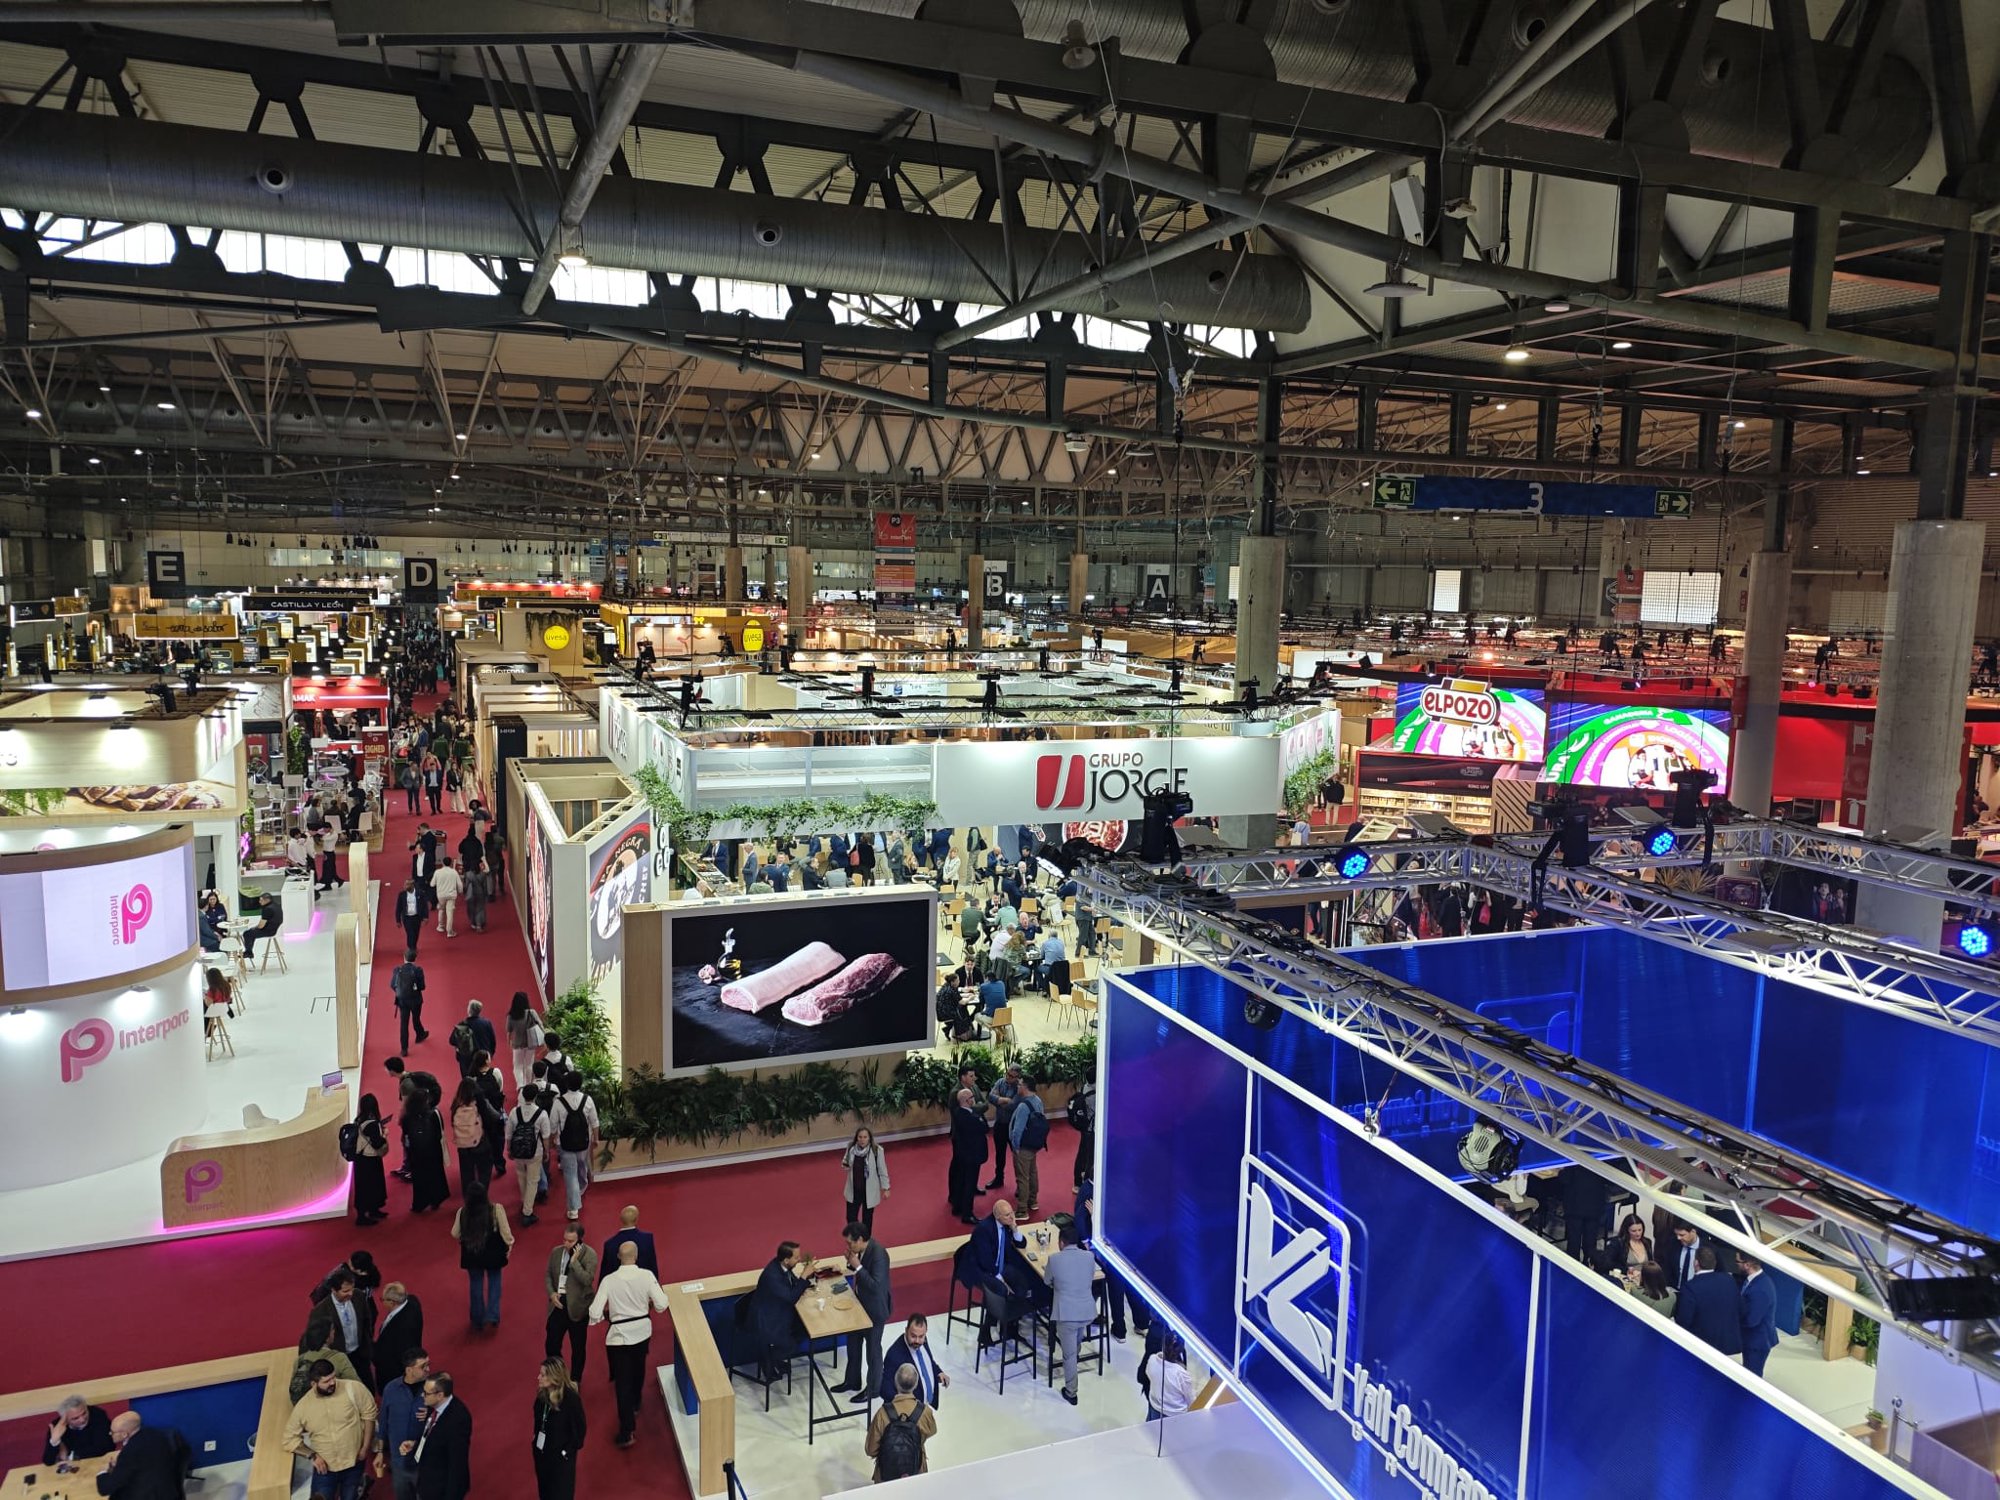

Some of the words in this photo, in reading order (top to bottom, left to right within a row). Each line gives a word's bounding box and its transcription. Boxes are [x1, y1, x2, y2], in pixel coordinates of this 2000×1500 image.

[1529, 482, 1544, 513] 3
[156, 555, 180, 582] E
[410, 561, 433, 587] D
[986, 575, 1003, 597] B
[1150, 577, 1167, 599] A
[270, 601, 313, 609] CASTILLA
[321, 600, 344, 609] LEÓN
[545, 633, 568, 642] uvesa
[744, 631, 763, 644] uvesa
[1088, 752, 1144, 768] GRUPO
[1086, 767, 1189, 814] JORGE
[109, 894, 120, 946] Interporc
[119, 1009, 189, 1050] Interporc
[1353, 1362, 1392, 1444] Vall
